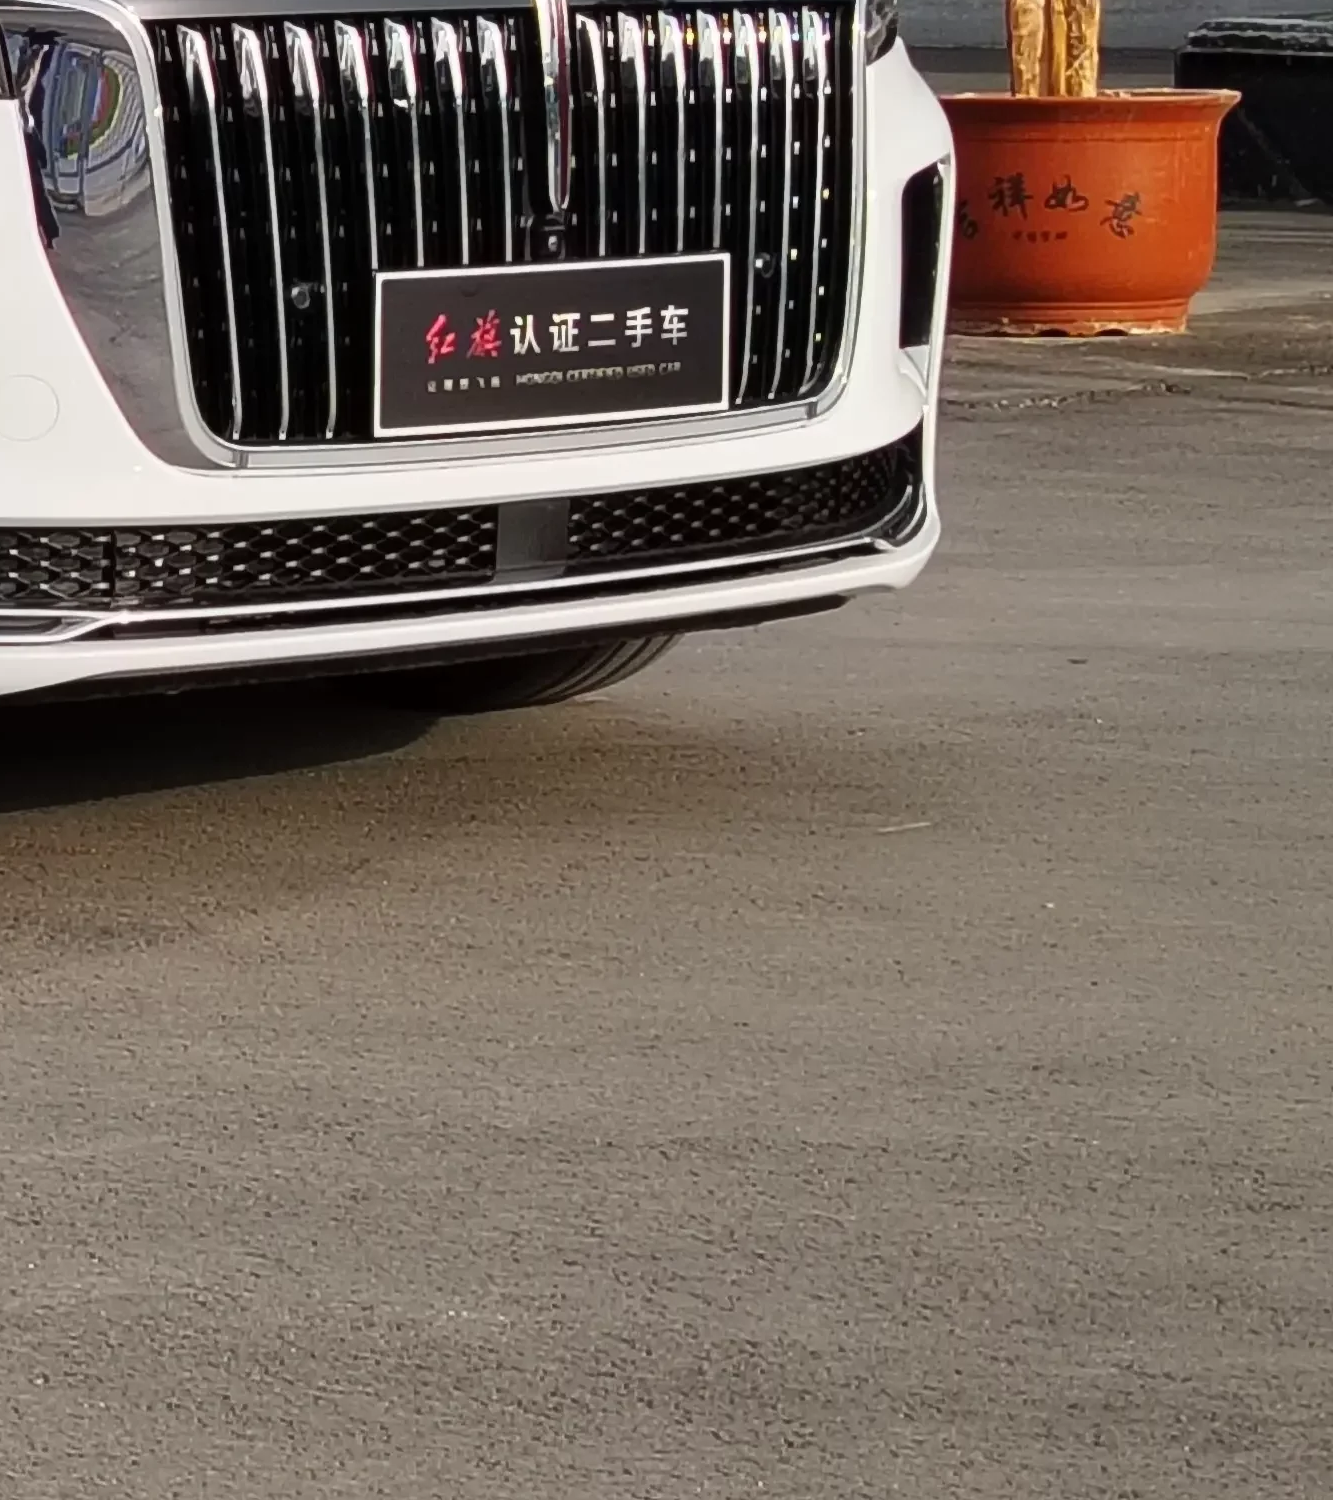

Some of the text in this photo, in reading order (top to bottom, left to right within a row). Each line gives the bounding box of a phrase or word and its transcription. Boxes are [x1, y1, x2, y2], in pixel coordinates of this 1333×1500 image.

[425, 304, 690, 364] 红旗认证二手车
